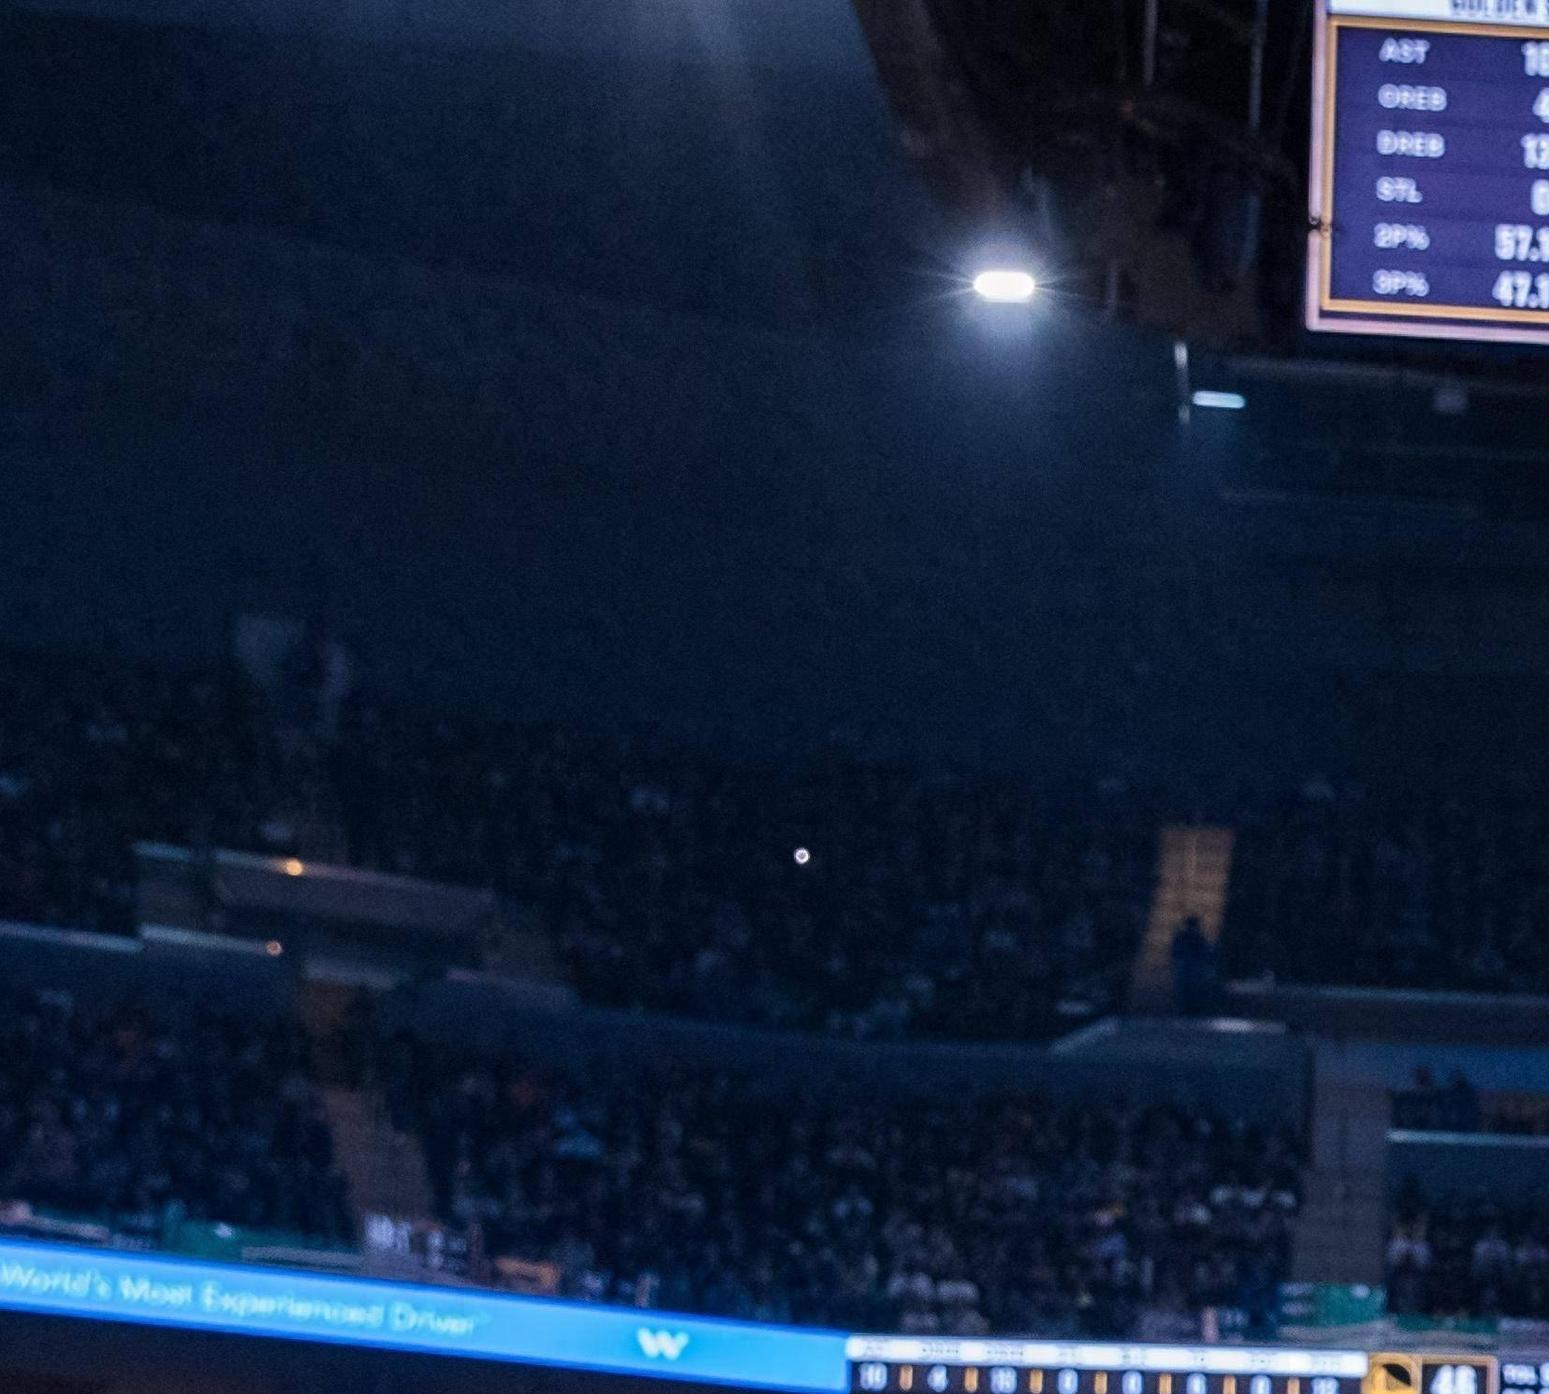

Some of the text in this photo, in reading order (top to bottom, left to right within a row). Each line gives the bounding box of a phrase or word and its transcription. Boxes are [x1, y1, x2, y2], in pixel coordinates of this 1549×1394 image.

[1379, 38, 1430, 63] AST
[1378, 84, 1447, 111] OREB
[1377, 130, 1445, 158] DREB
[1376, 176, 1423, 203] STL
[1373, 222, 1430, 250] 2P%
[1372, 269, 1430, 297] 3P%
[118, 1275, 193, 1304] Most
[201, 1280, 384, 1331] Experienced
[391, 1301, 475, 1337] Driver
